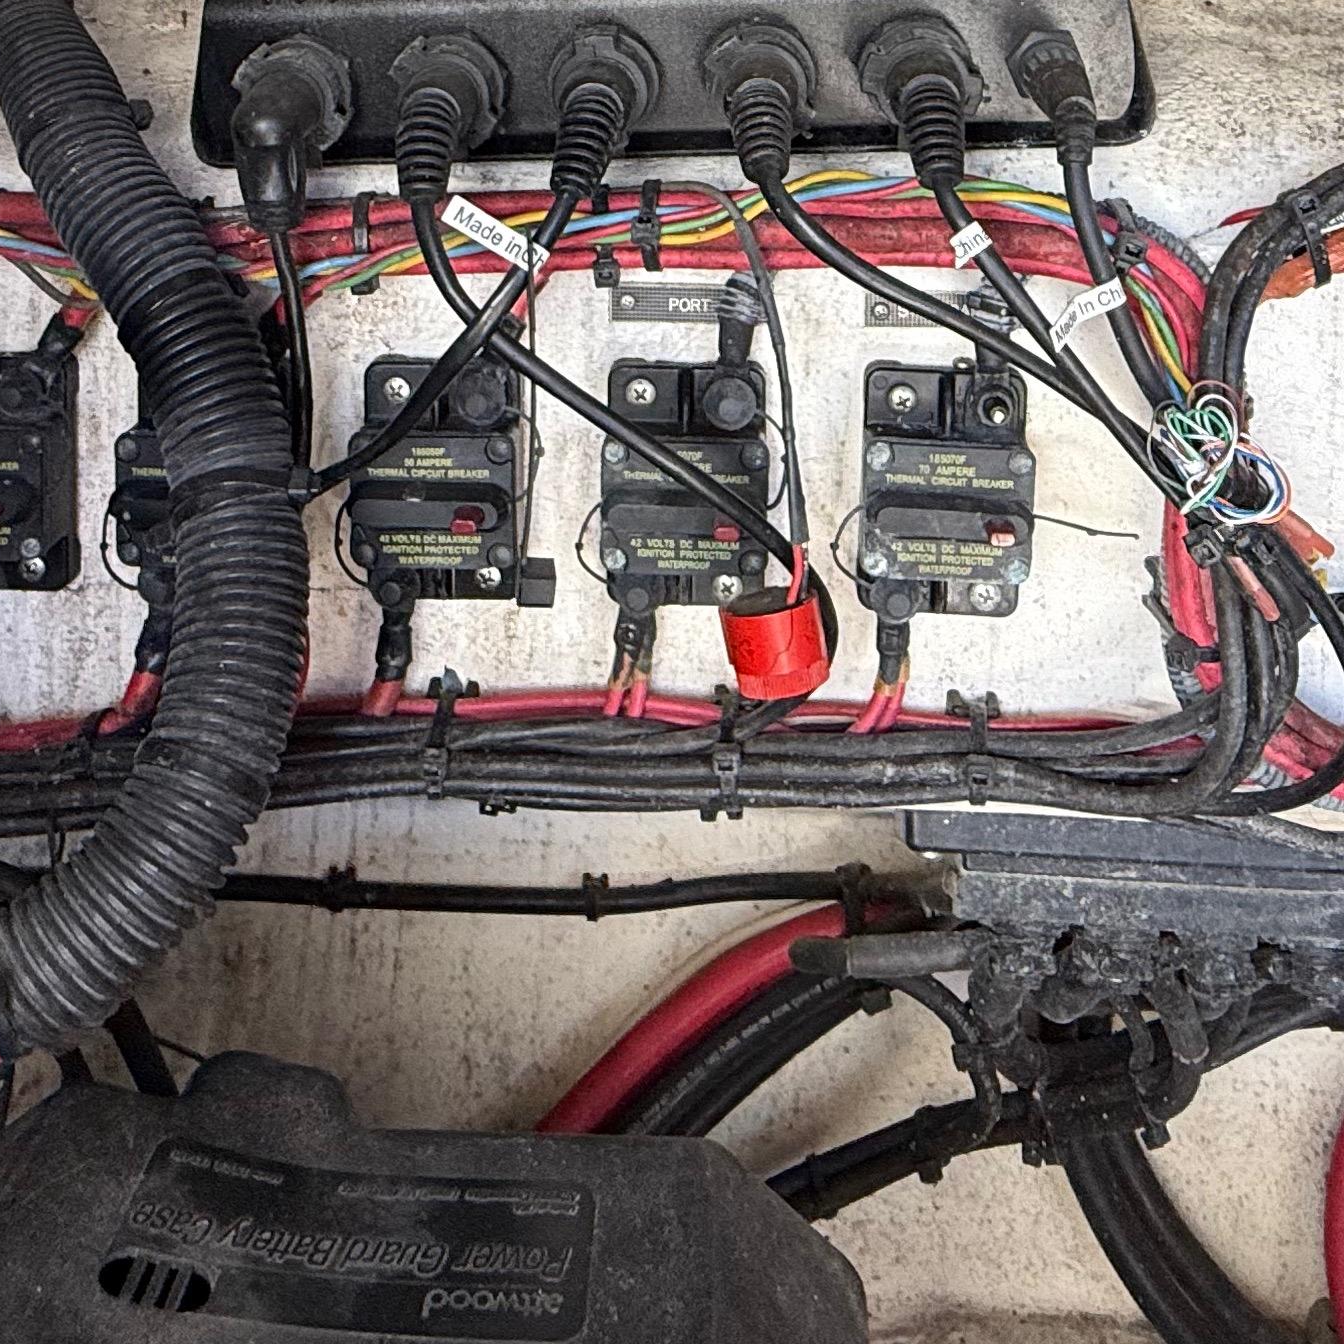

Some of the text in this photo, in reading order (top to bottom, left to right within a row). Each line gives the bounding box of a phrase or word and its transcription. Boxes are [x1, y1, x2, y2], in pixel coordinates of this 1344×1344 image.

[453, 206, 503, 246] Made
[668, 297, 712, 313] PORT
[1055, 310, 1078, 343] Made
[1078, 301, 1096, 315] In
[404, 458, 453, 467] 50 AMPERE
[929, 453, 967, 464] 185070F
[131, 467, 168, 476] THERMA
[367, 467, 490, 479] THERMAL CIRCUIT BREAKER
[623, 470, 664, 481] THERMAL
[918, 465, 976, 477] 70 AMPERE
[885, 473, 1014, 490] THERMAL CIRCUIT BREAKER
[379, 534, 482, 544] 42 VOLTS DC MAXIMUM
[630, 538, 740, 550] 42 VOLTS DC MAXIMUM
[382, 545, 479, 555] IGNITION PROTECTED
[637, 548, 732, 560] IGNITION PROTECTED
[891, 543, 1003, 556] 42 VOLTS DC MAXIMUM
[398, 555, 463, 565] WATERPROOF
[657, 559, 711, 570] WATERPROOF
[897, 553, 994, 566] IGNITION PROTECTED
[918, 564, 973, 575] WATERPROOF
[130, 1200, 573, 1282] Power Guard Battery Case
[422, 1287, 564, 1320] attwood
